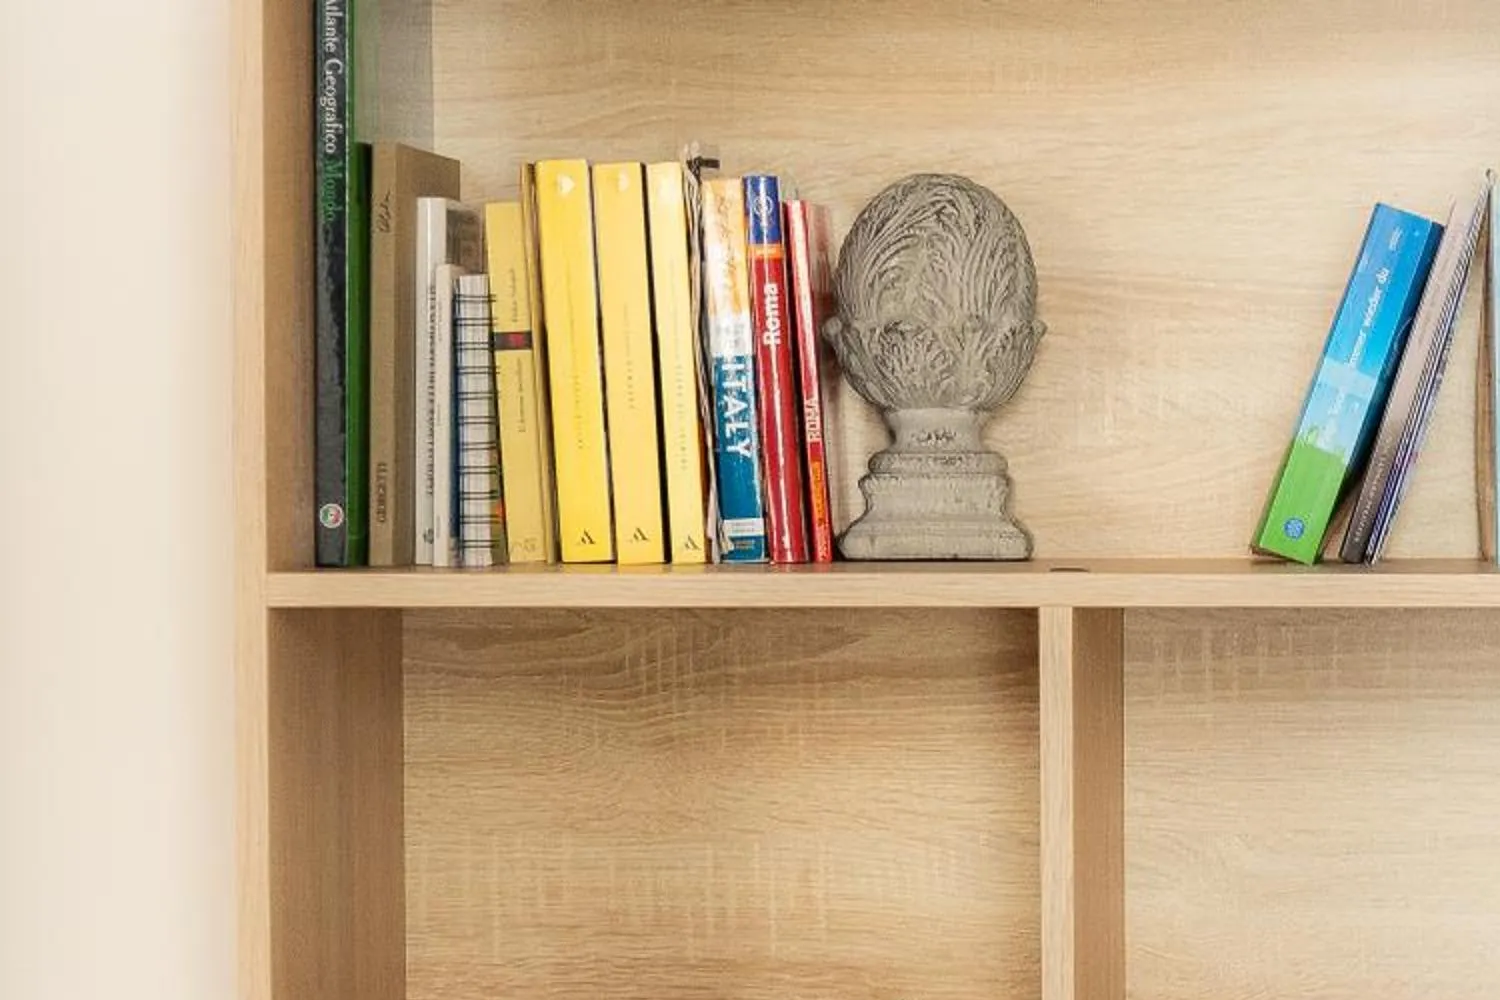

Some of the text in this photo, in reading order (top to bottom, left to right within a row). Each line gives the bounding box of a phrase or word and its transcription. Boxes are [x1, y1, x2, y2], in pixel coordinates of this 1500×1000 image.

[320, 58, 343, 153] Geografico
[324, 158, 343, 221] Mondo
[763, 283, 782, 346] Roma
[722, 363, 753, 458] ITALY
[806, 397, 823, 442] ROMA
